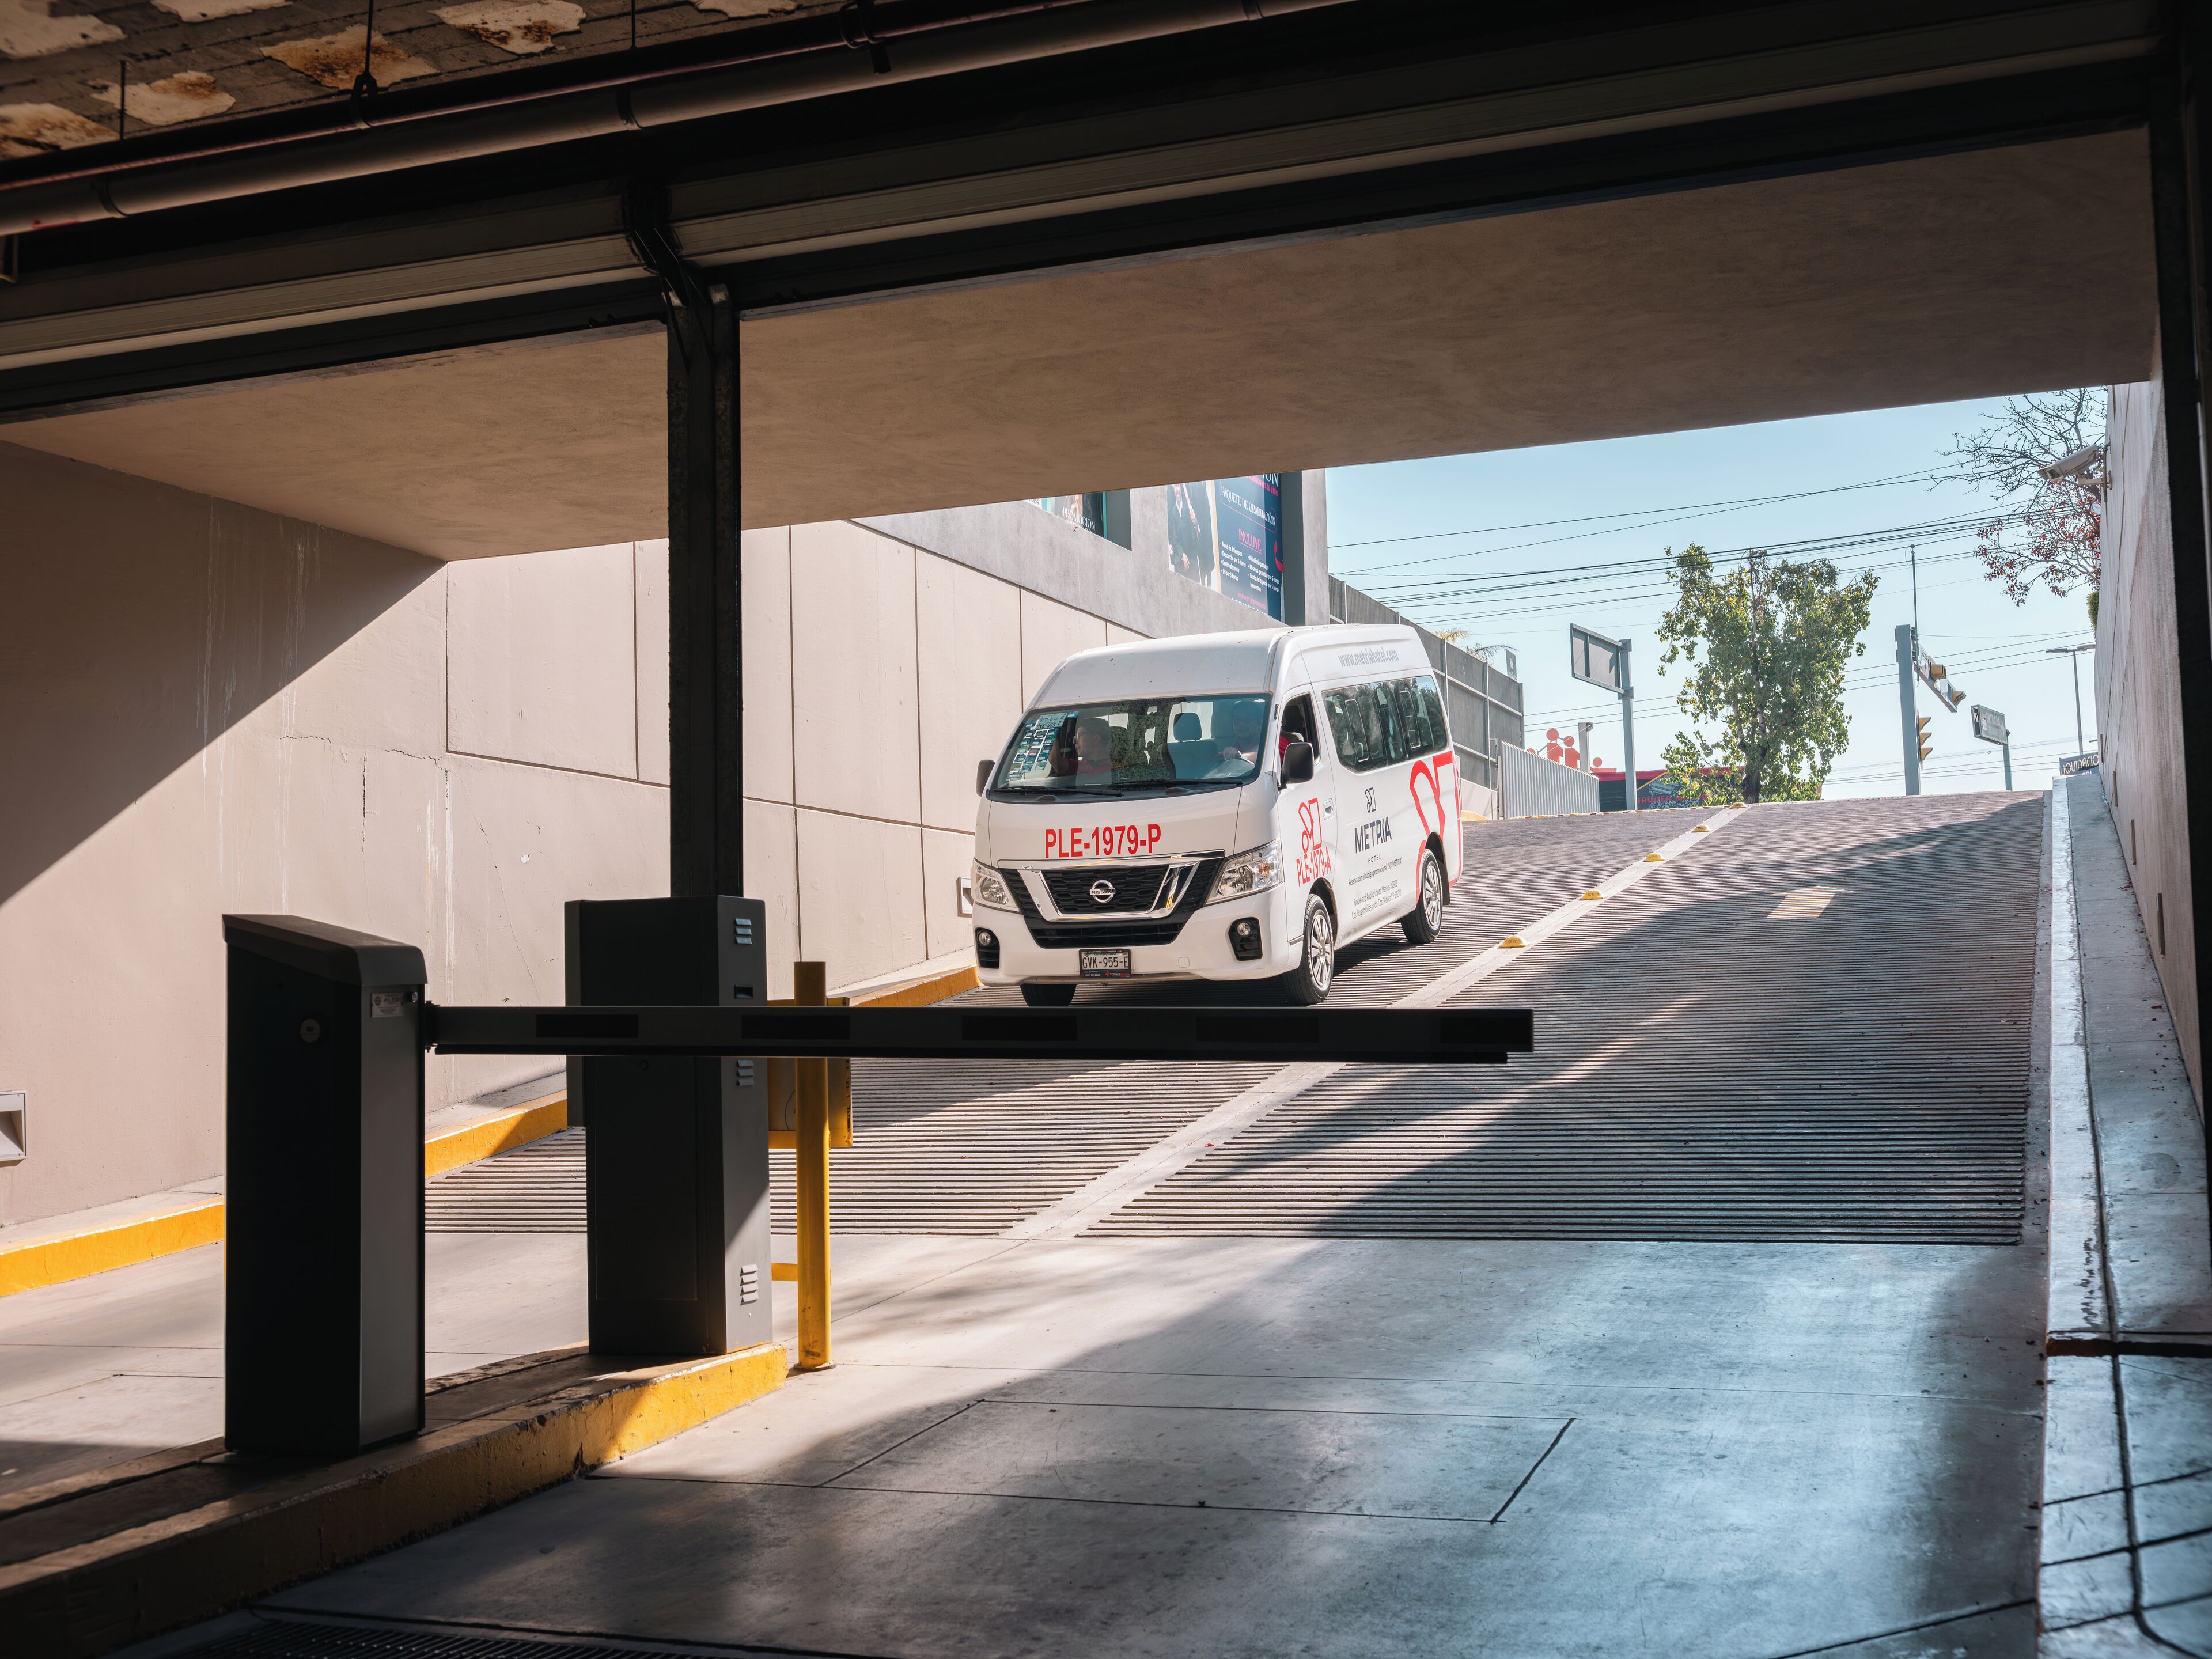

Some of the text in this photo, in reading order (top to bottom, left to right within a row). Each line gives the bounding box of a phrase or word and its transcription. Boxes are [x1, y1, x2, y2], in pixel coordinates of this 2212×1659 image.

[1062, 506, 1096, 531] PROMOCIÓN
[1221, 486, 1276, 526] PAQUETE DE GRADUACIÓN
[1238, 528, 1262, 552] INCLUYE
[1338, 646, 1399, 667] www.metriahotel.com
[1046, 824, 1161, 858] PLE-1979-P
[1354, 816, 1392, 854] METRIA
[1296, 846, 1332, 888] PLE-1979-A
[1368, 854, 1382, 863] HOTEL
[1082, 956, 1129, 968] GVK-955-E
